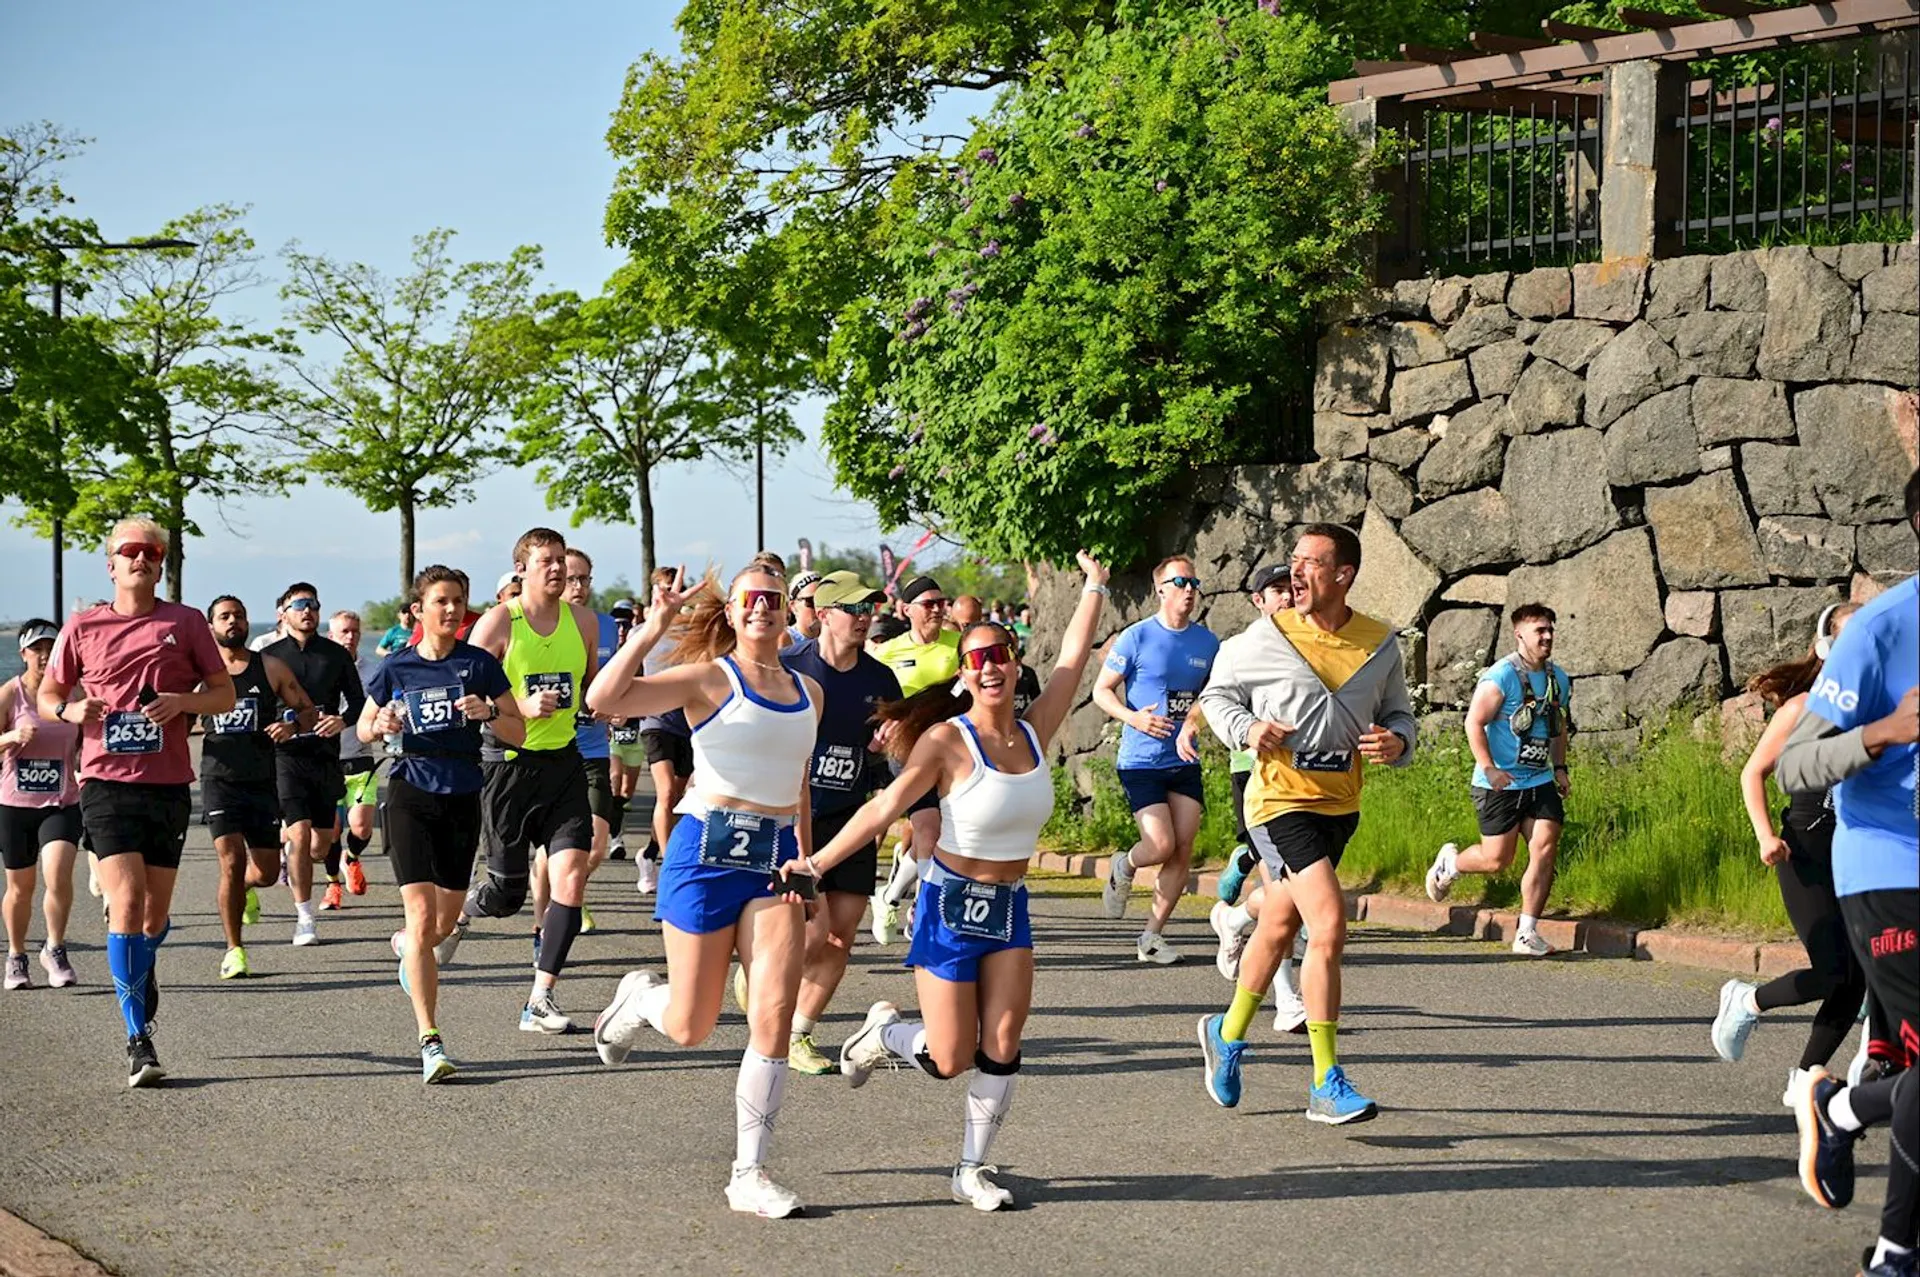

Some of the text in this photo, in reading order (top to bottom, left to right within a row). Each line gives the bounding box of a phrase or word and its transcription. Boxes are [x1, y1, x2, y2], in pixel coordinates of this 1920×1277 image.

[419, 700, 452, 724] 351
[1169, 699, 1194, 713] 305
[108, 723, 158, 744] 2632
[19, 767, 59, 784] 3009
[816, 755, 855, 780] 1812
[729, 830, 750, 857] 2
[963, 897, 990, 924] 10
